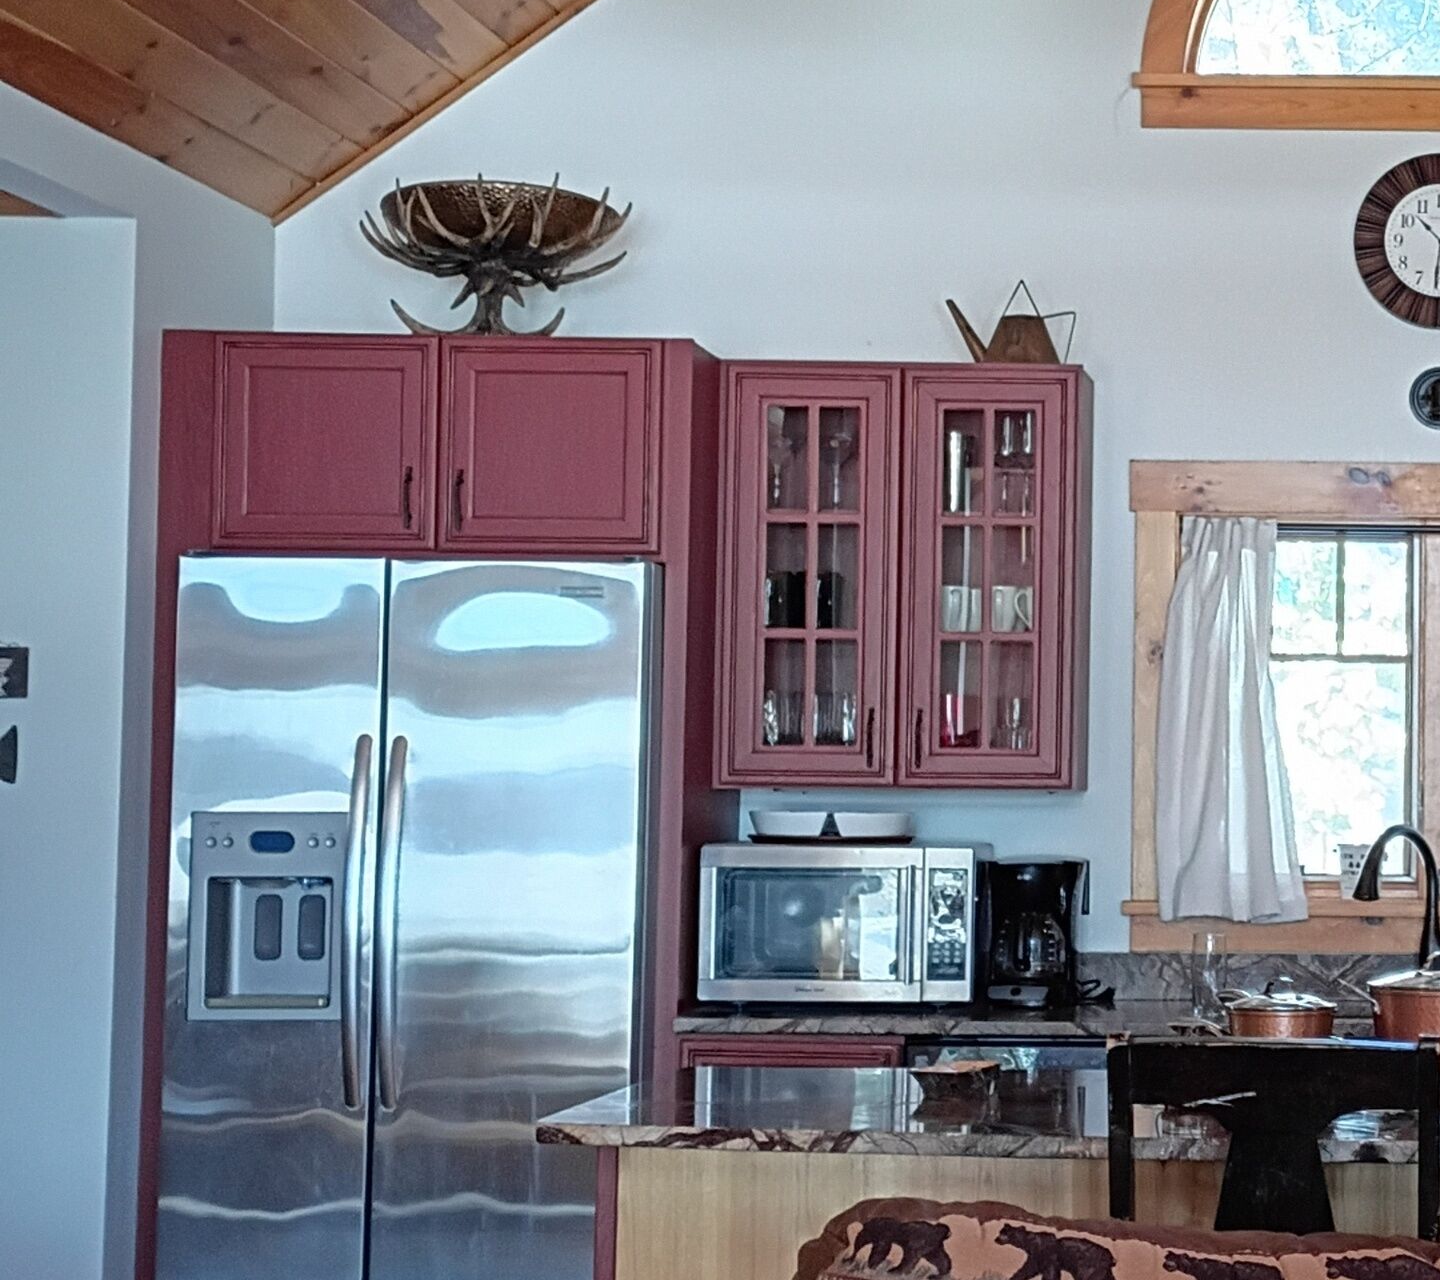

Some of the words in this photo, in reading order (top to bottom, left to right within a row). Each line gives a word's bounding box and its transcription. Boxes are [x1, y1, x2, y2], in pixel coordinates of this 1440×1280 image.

[1417, 199, 1428, 214] 11
[1401, 214, 1415, 228] 10
[1393, 233, 1404, 248] 9
[1398, 255, 1408, 270] 8
[1415, 270, 1424, 285] 7
